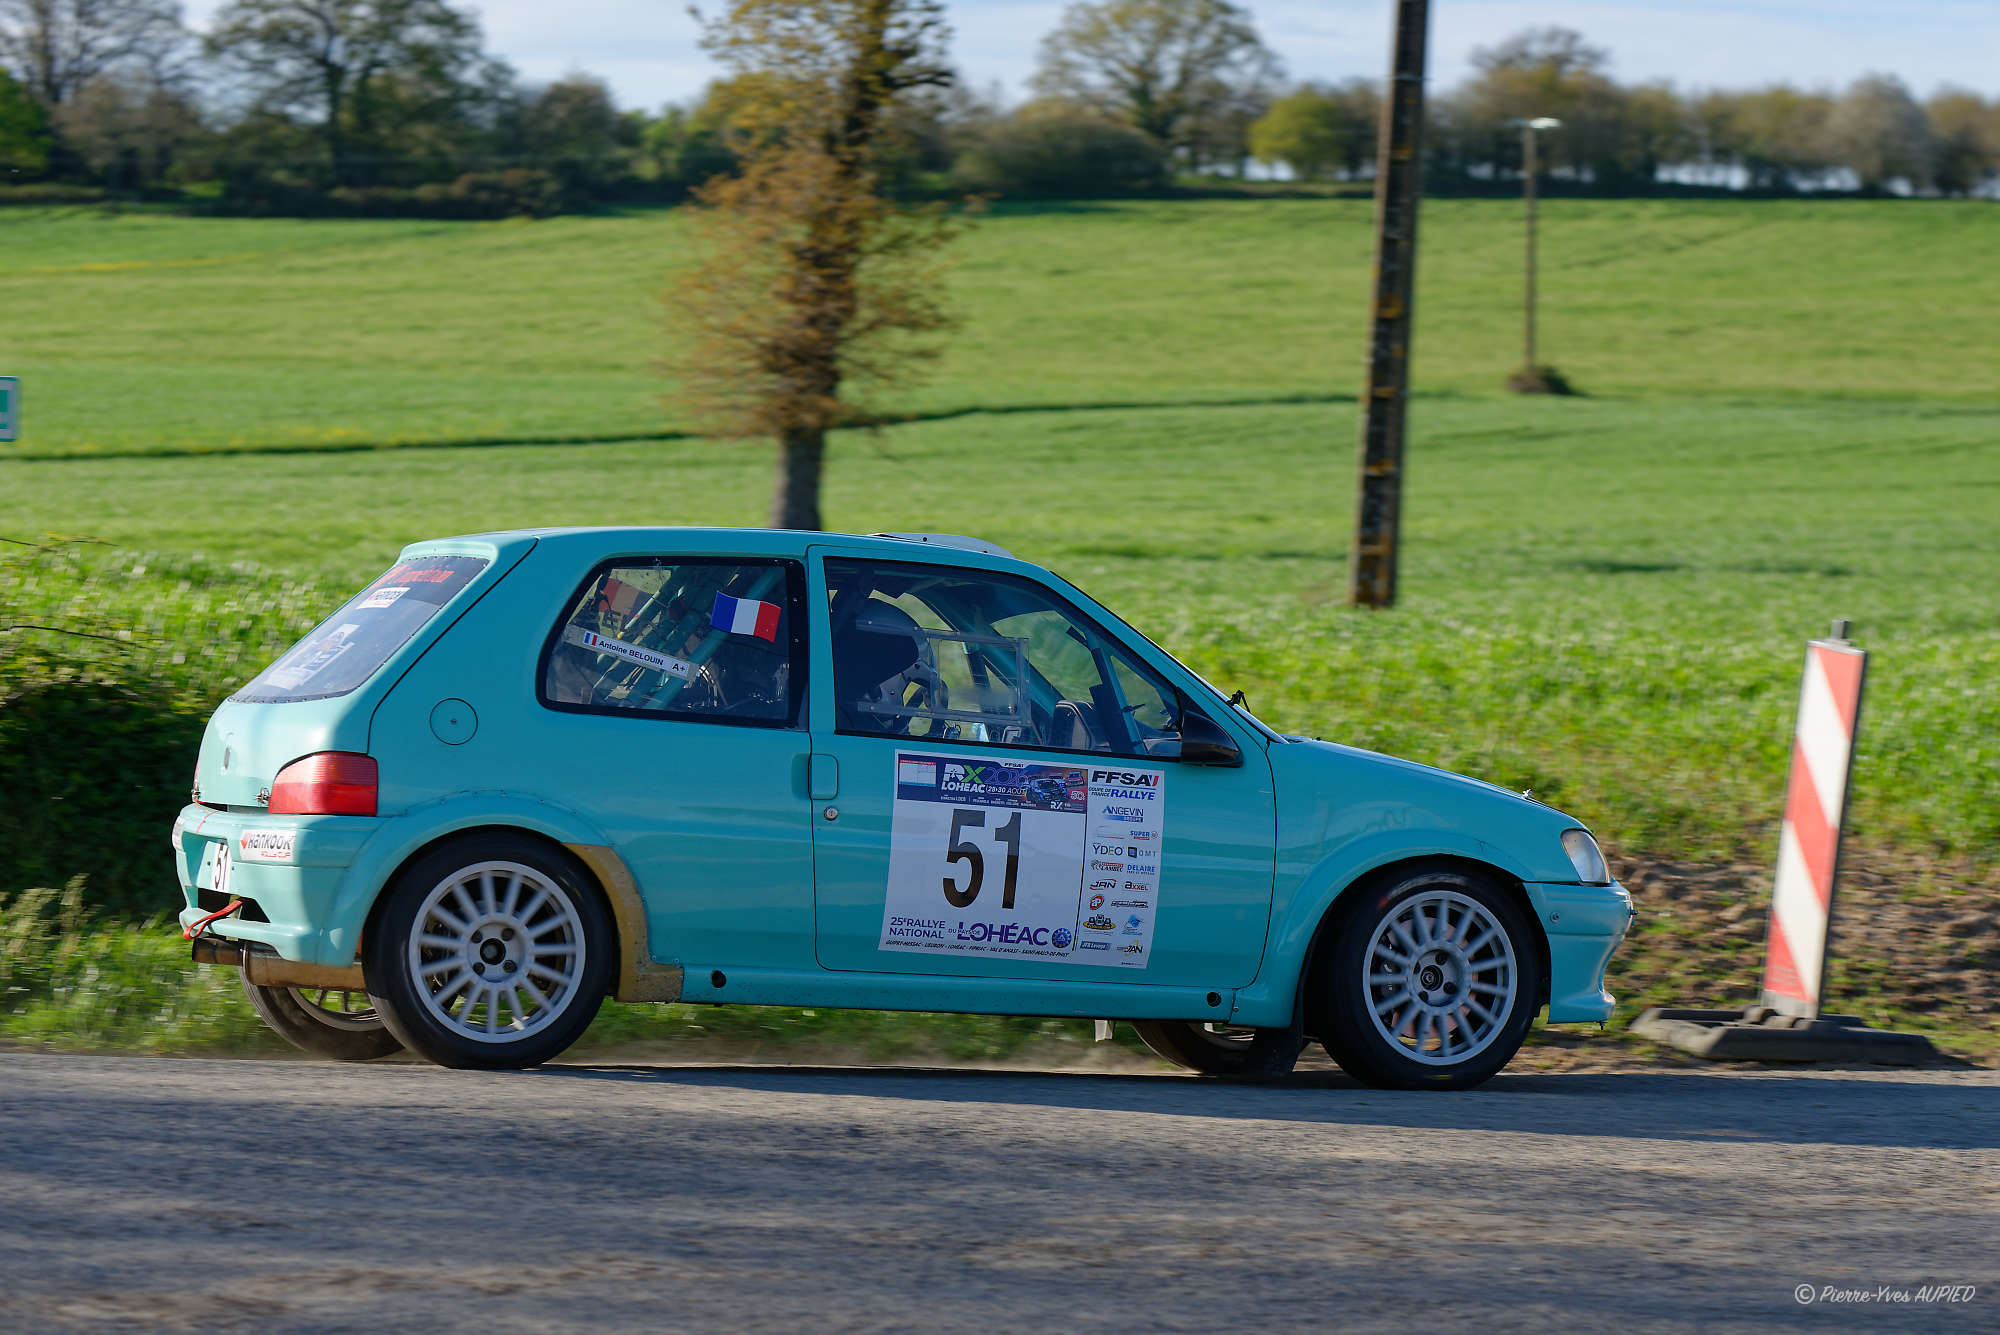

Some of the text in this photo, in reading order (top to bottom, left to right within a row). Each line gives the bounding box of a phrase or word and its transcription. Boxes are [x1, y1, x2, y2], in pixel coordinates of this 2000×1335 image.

[599, 640, 686, 672] Antoine BELOUIN A+
[943, 763, 986, 784] RX
[1092, 770, 1154, 786] FFSA
[941, 782, 986, 794] LOHEAC
[1110, 789, 1155, 800] RALLYE
[1102, 805, 1144, 816] ANGEVIN
[942, 808, 1022, 909] 51
[1127, 864, 1155, 873] DELAIRE
[906, 918, 946, 929] RALLYE
[889, 927, 944, 939] NATIONAL
[957, 921, 1050, 946] LOHÉAC
